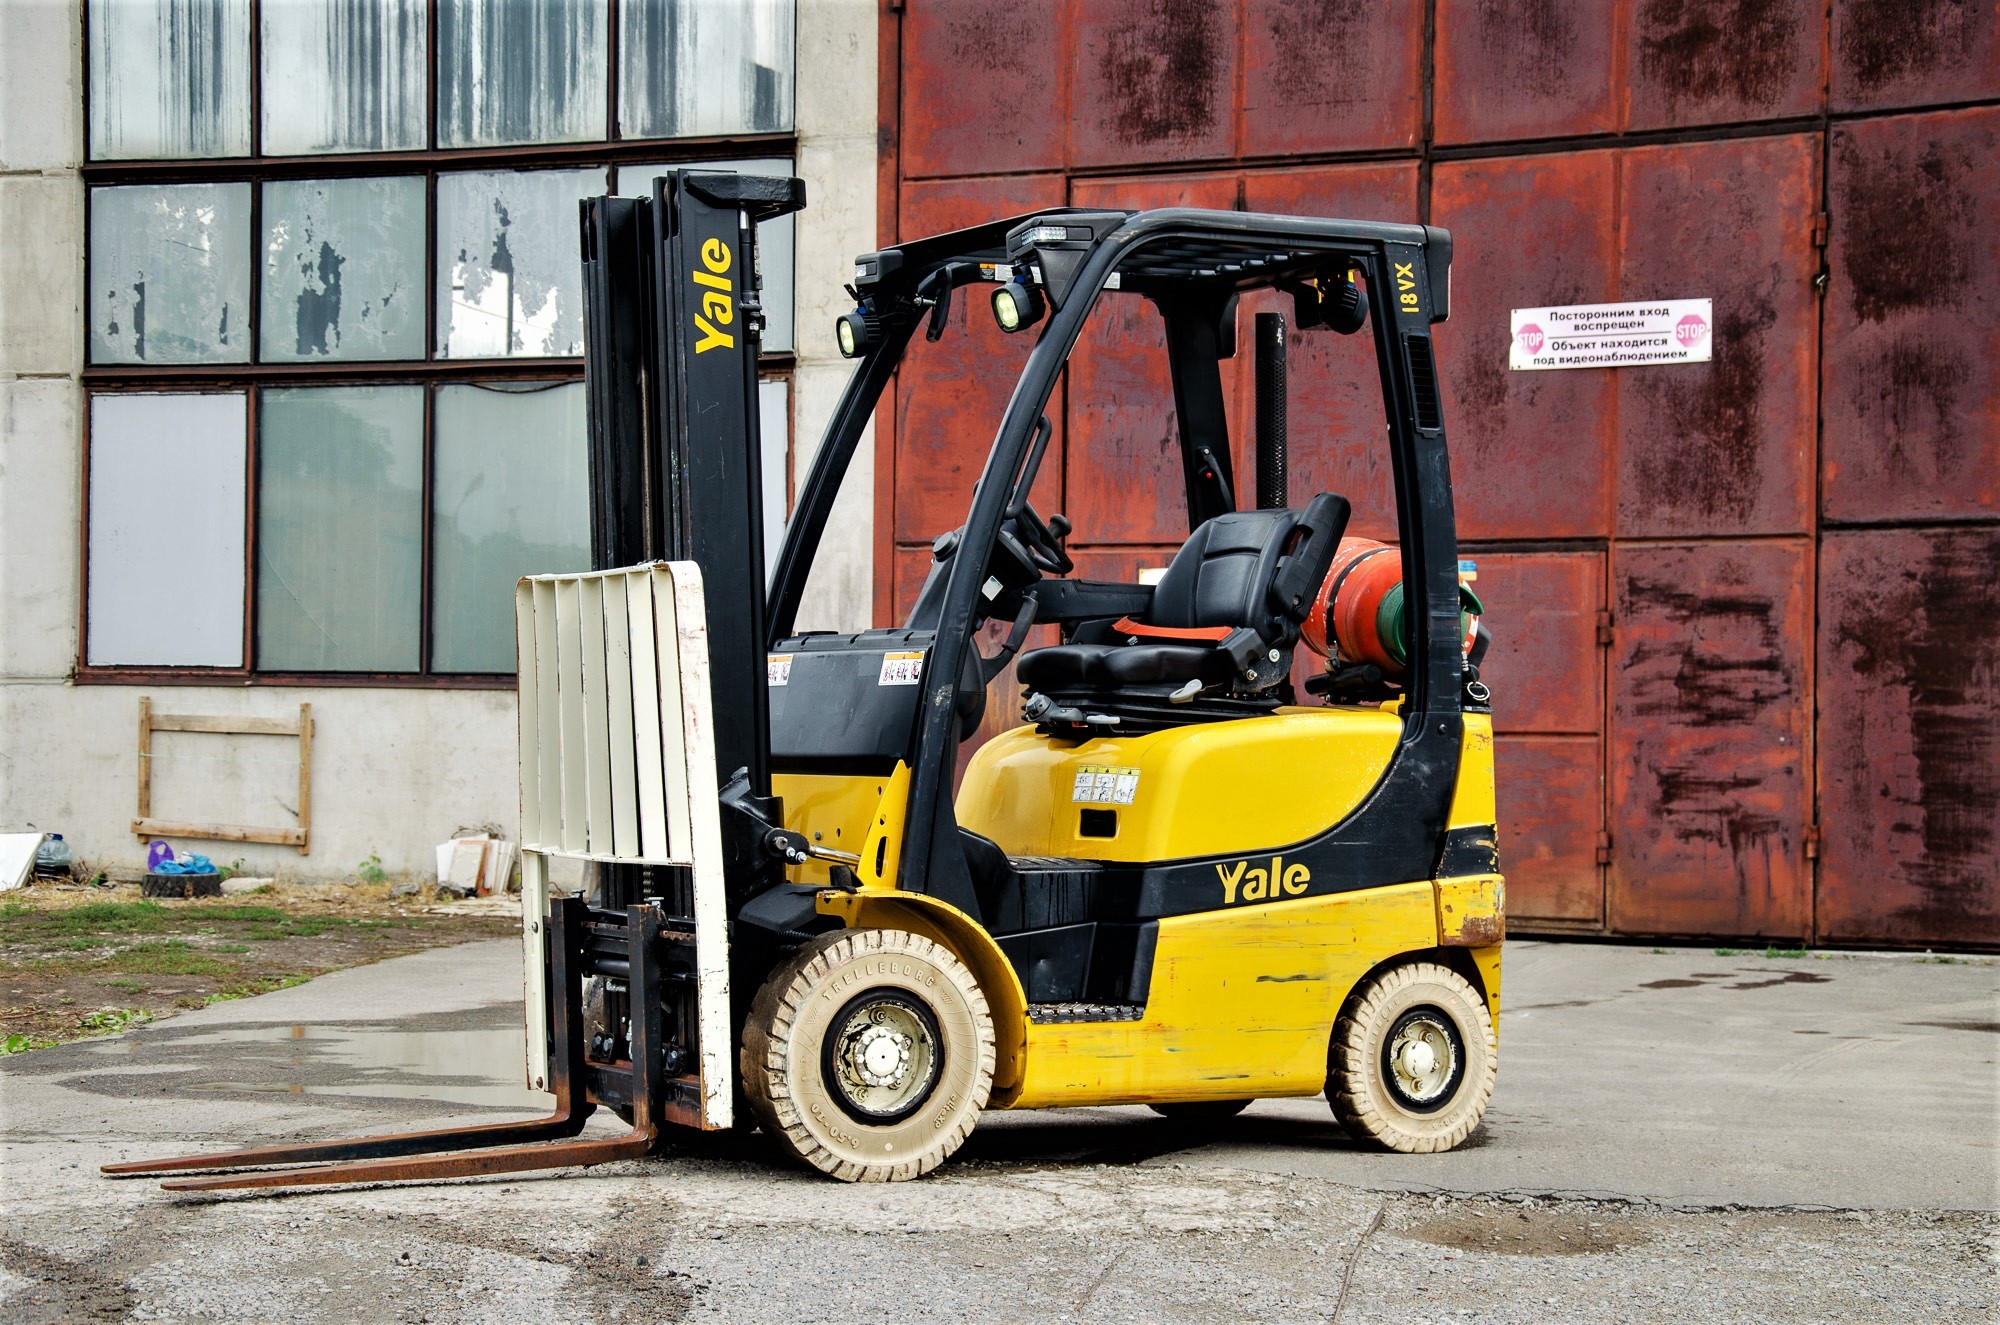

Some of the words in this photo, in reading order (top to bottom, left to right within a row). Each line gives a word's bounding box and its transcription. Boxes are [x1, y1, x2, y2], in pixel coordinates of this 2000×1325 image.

[693, 238, 734, 354] Yale
[1550, 309, 1635, 321] Посторонним
[1639, 308, 1670, 317] вход
[1574, 320, 1645, 332] воспрещен
[1677, 323, 1706, 340] STOP
[1516, 332, 1543, 349] STOP
[1552, 340, 1597, 351] Объект
[1601, 338, 1668, 350] находится
[1533, 356, 1555, 367] под
[1559, 350, 1688, 365] видеонаблюдением
[1215, 856, 1311, 904] Yale
[822, 962, 935, 1001] TRELLEBORG
